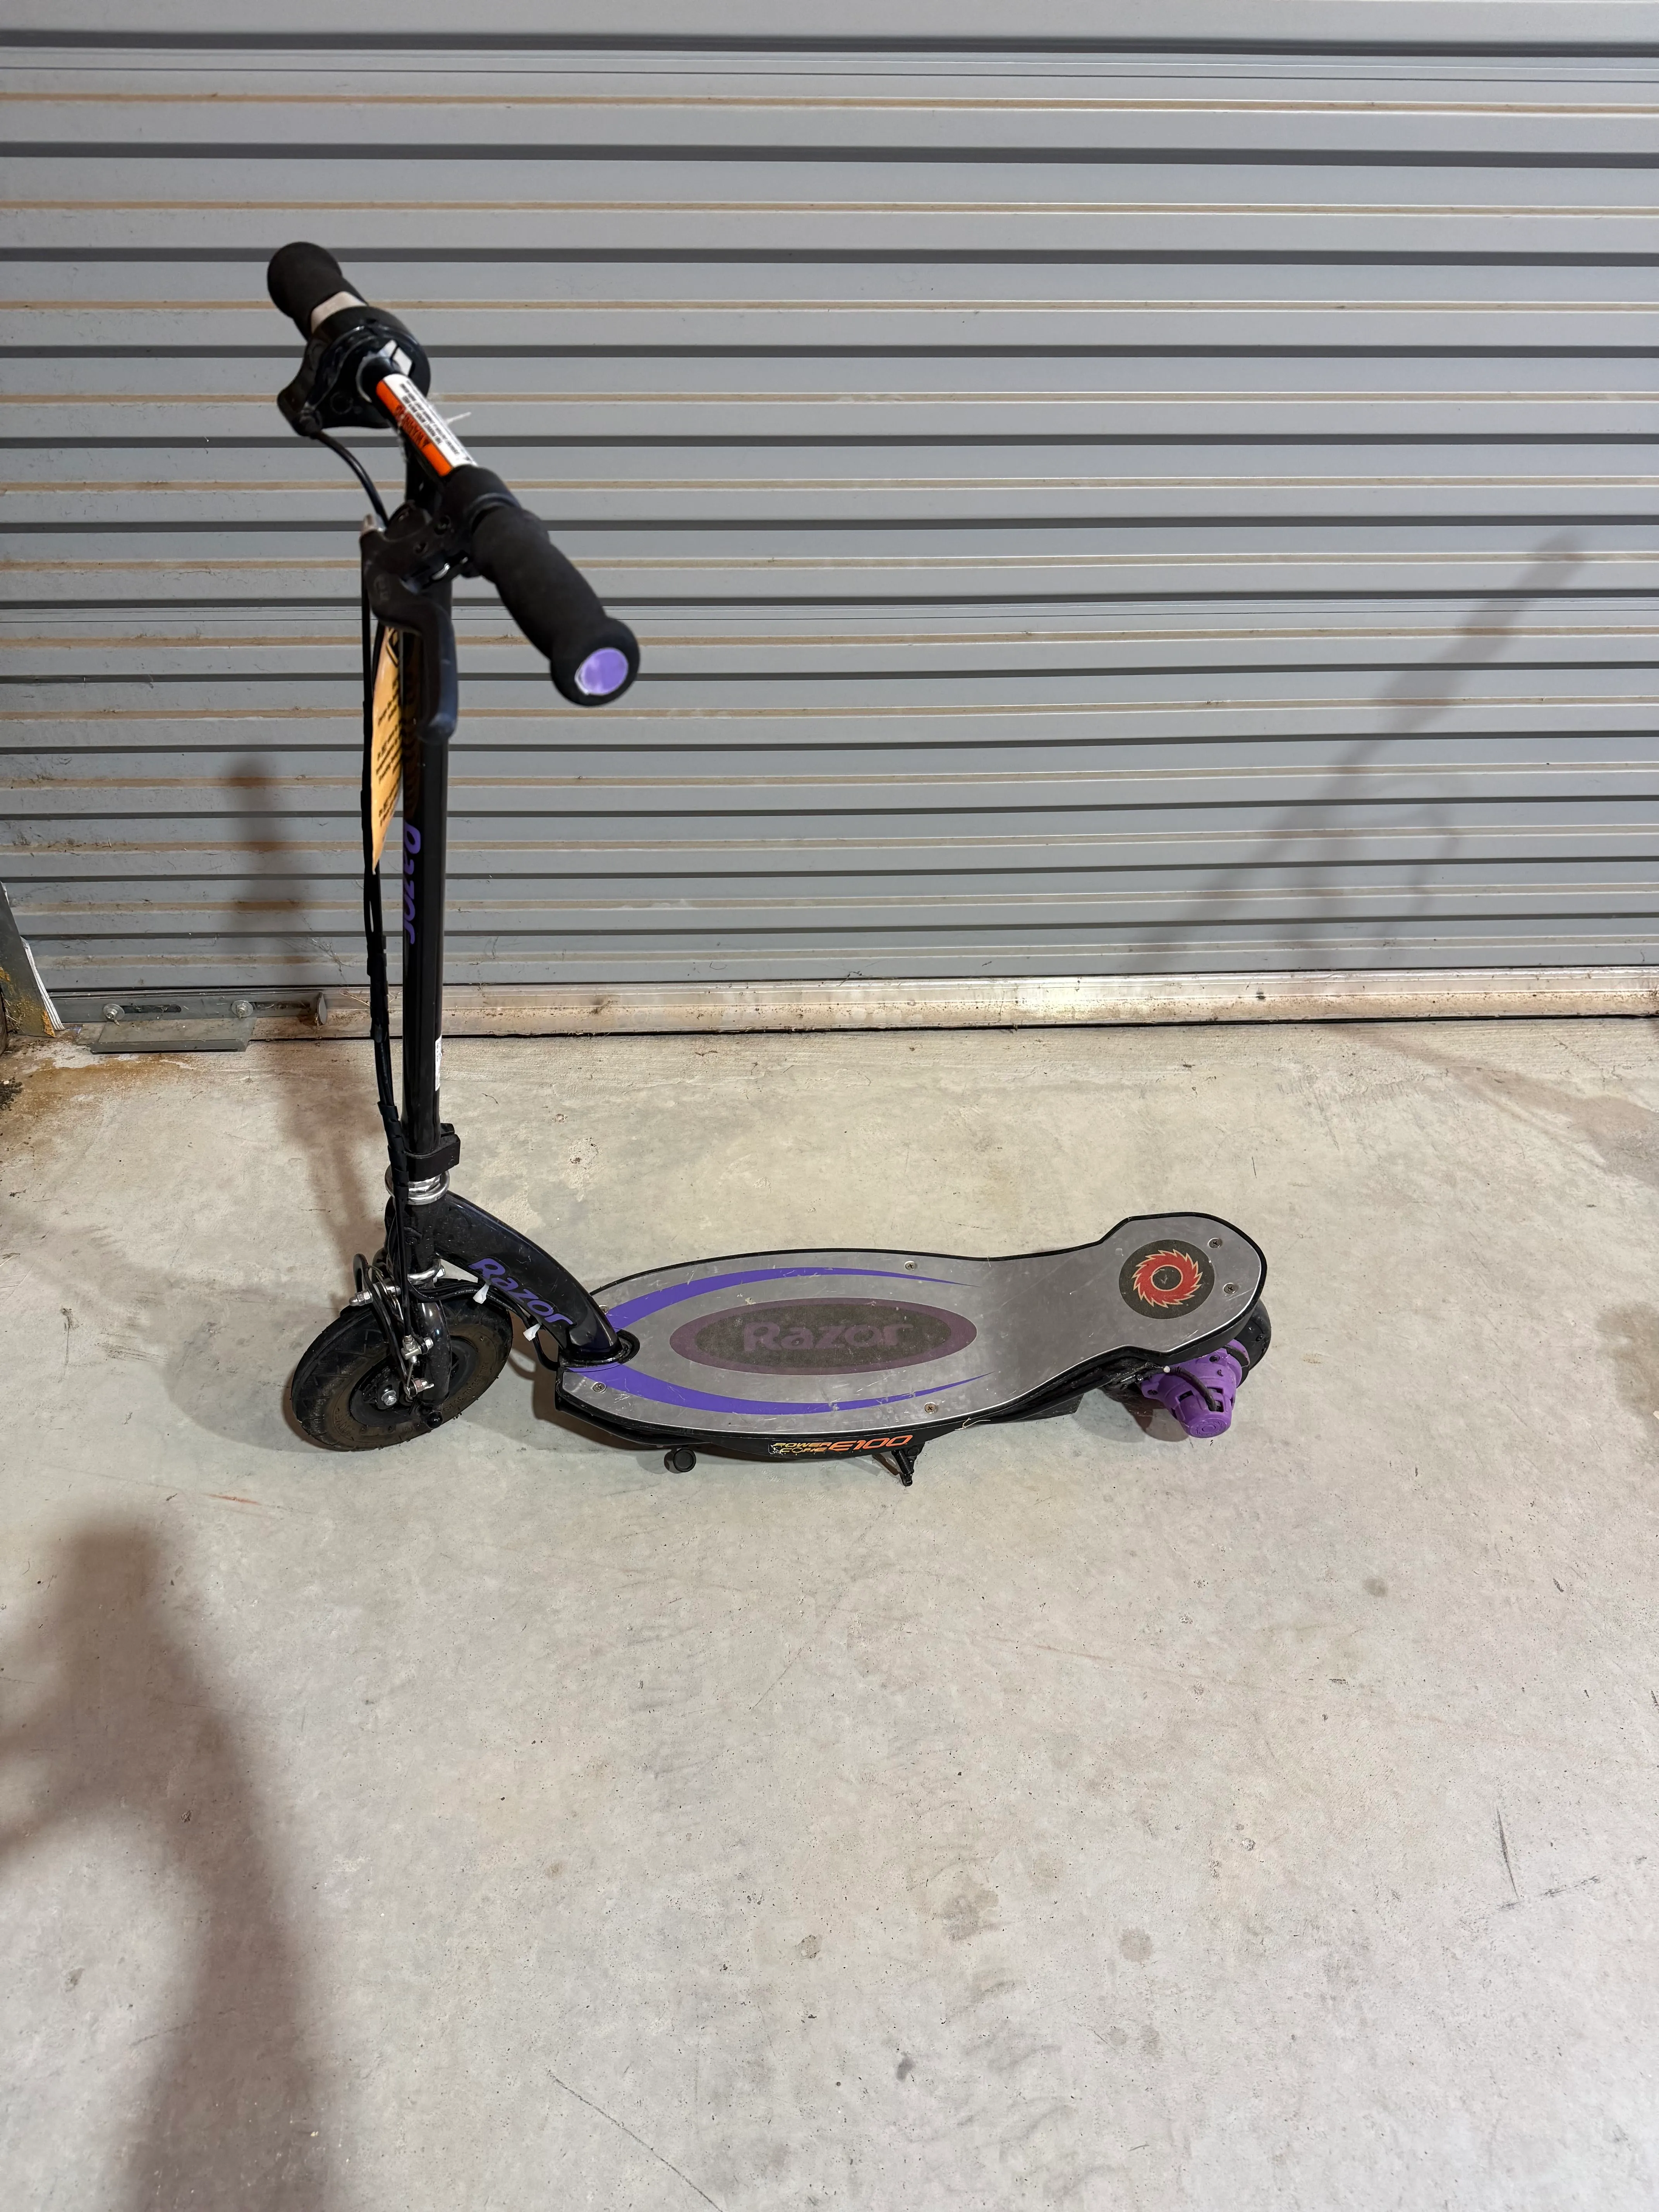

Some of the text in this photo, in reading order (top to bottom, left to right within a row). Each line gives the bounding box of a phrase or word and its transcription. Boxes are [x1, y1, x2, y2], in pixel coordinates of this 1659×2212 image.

[468, 1258, 573, 1325] Razor
[744, 1321, 914, 1352] Razor
[828, 1435, 913, 1451] E100
